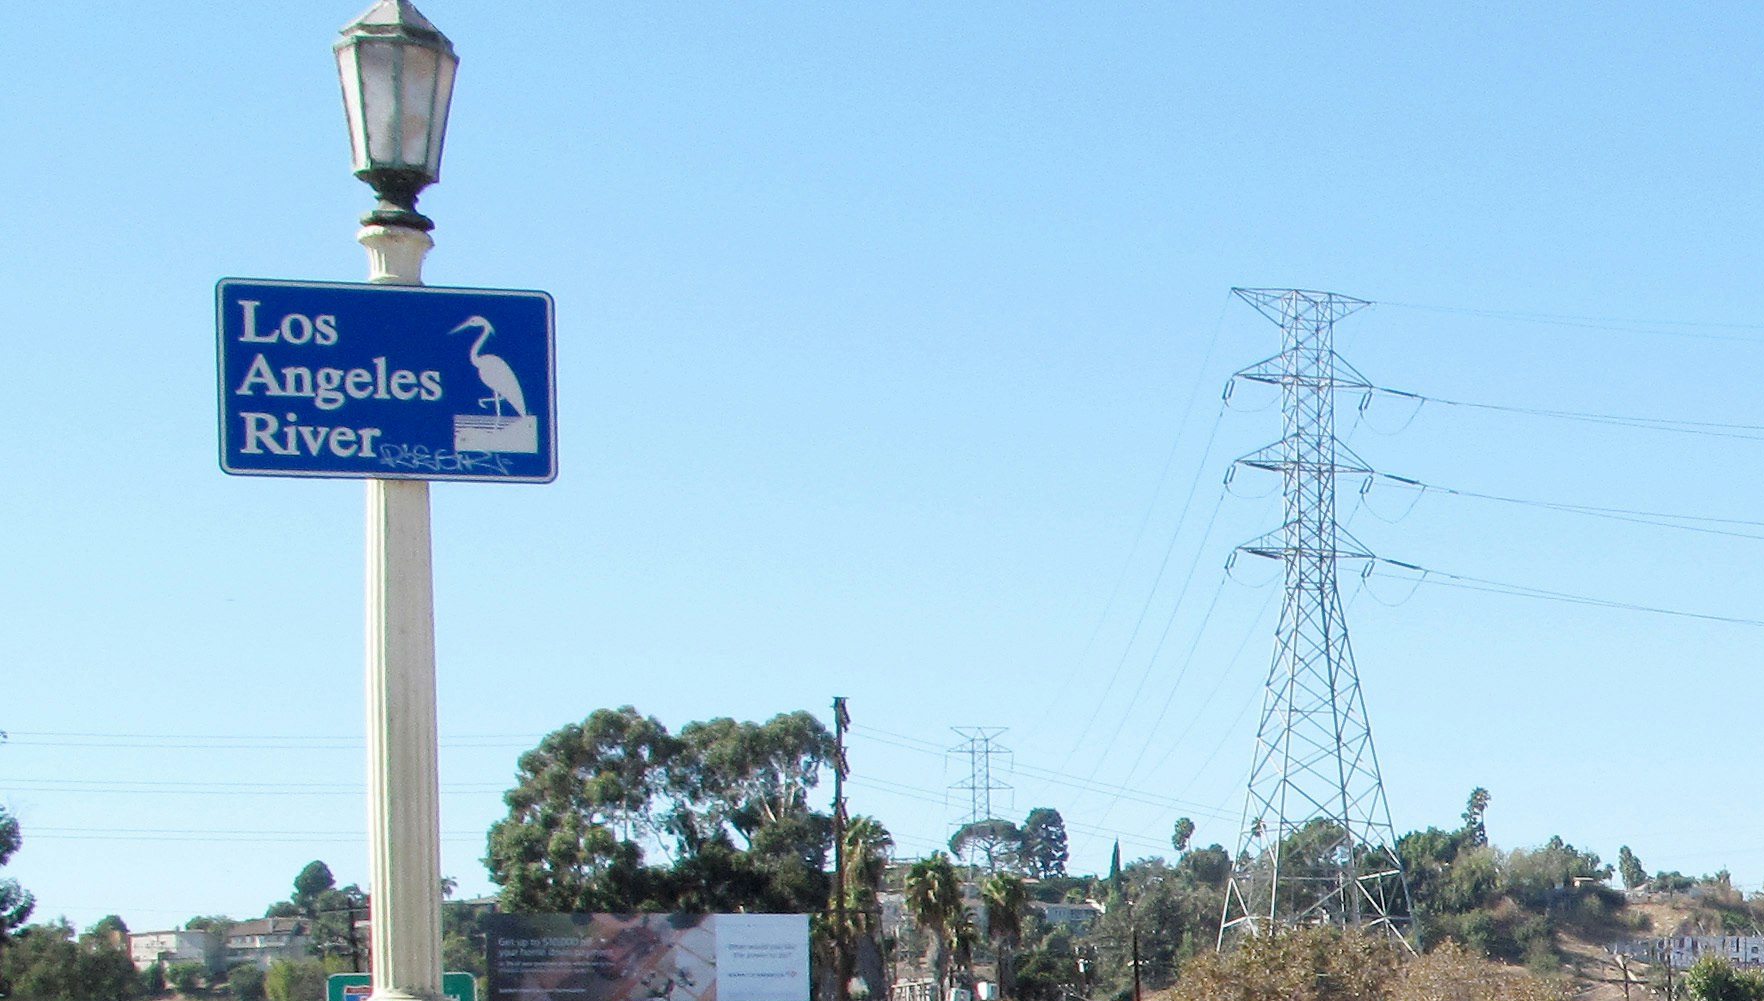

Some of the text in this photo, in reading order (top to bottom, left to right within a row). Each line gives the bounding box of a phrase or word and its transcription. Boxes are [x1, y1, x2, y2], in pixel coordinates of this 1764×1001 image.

[238, 299, 339, 346] Los
[235, 353, 443, 410] Angeles
[239, 411, 382, 458] River
